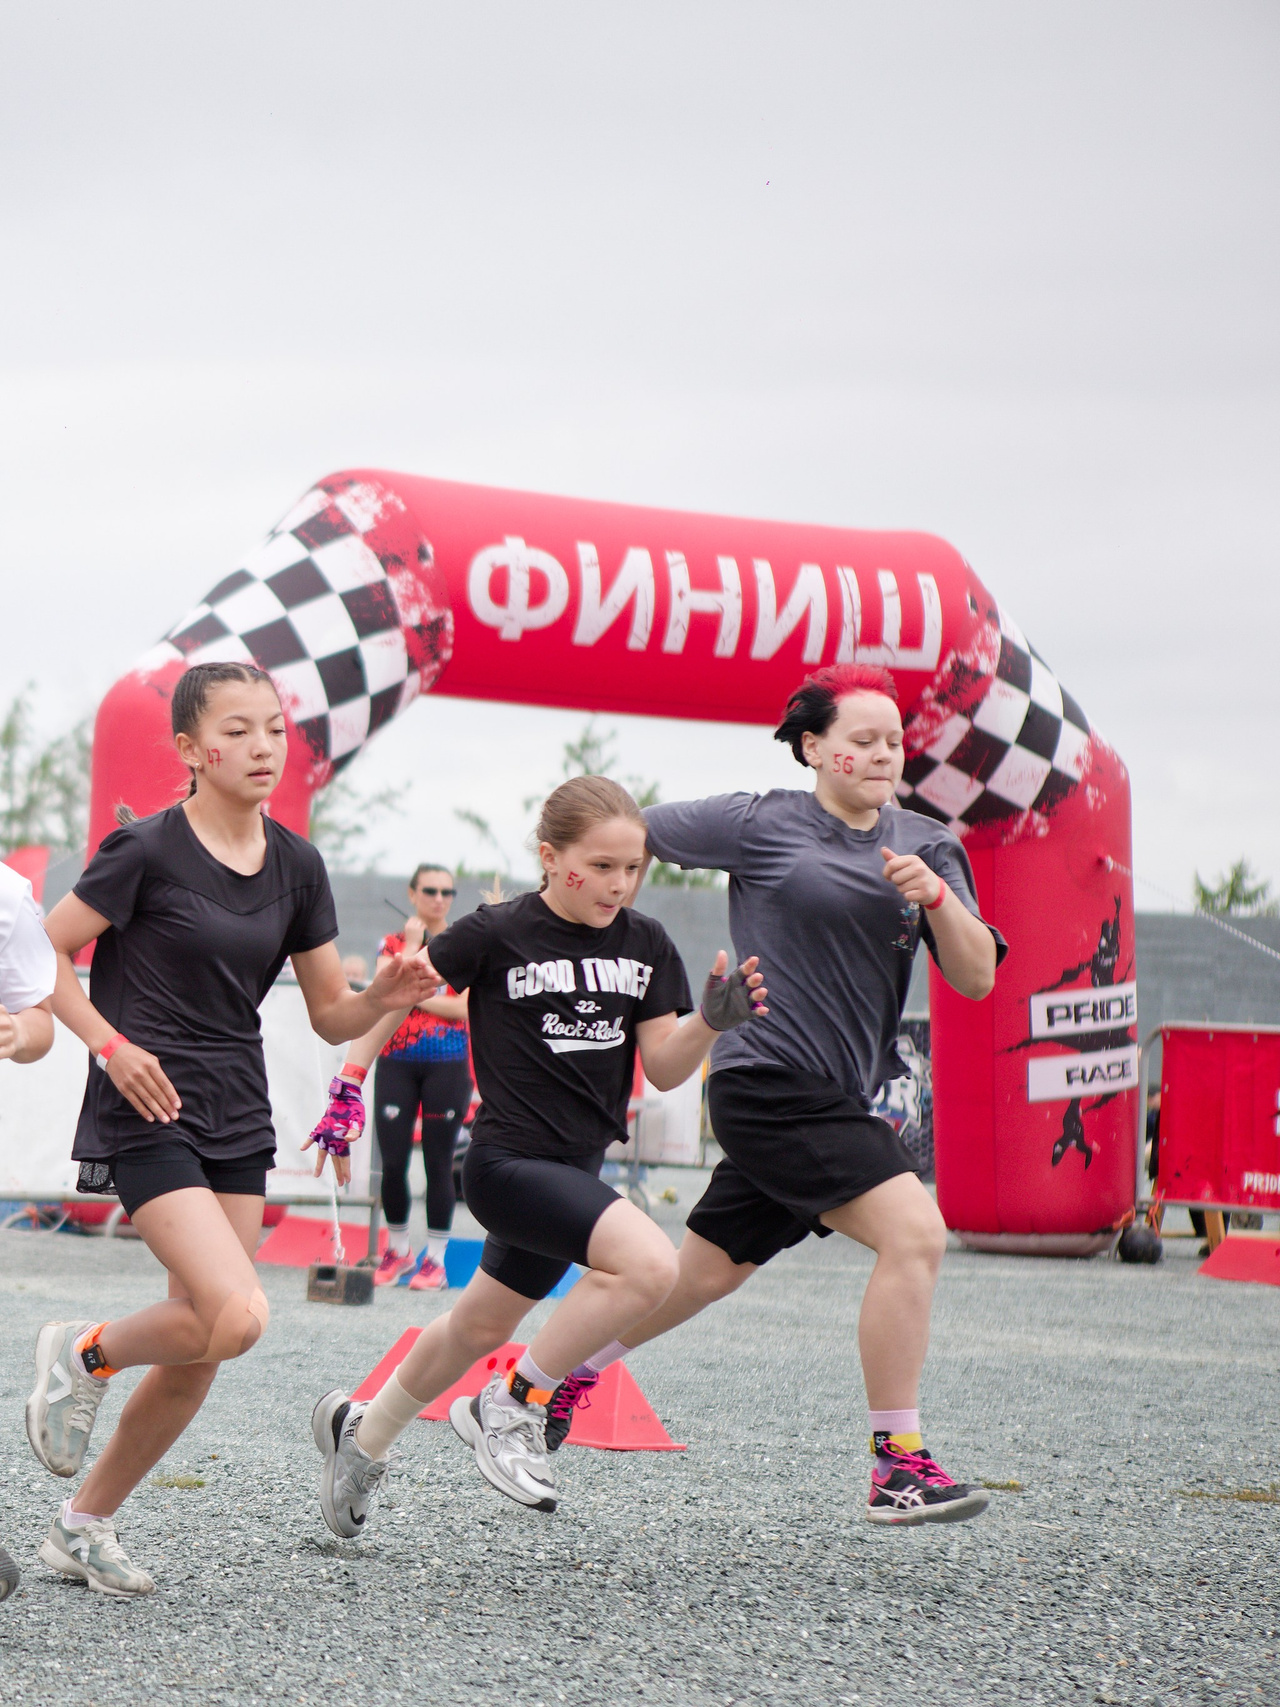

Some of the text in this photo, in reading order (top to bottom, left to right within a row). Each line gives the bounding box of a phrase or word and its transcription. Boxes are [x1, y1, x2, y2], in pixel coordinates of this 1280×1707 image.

[466, 535, 942, 671] ФИНИШ
[206, 748, 223, 769] 47
[832, 753, 855, 775] 56
[565, 871, 585, 891] 51
[507, 959, 576, 1000] GOOD
[1046, 994, 1135, 1028] PRIDE
[1065, 1059, 1133, 1087] RACE
